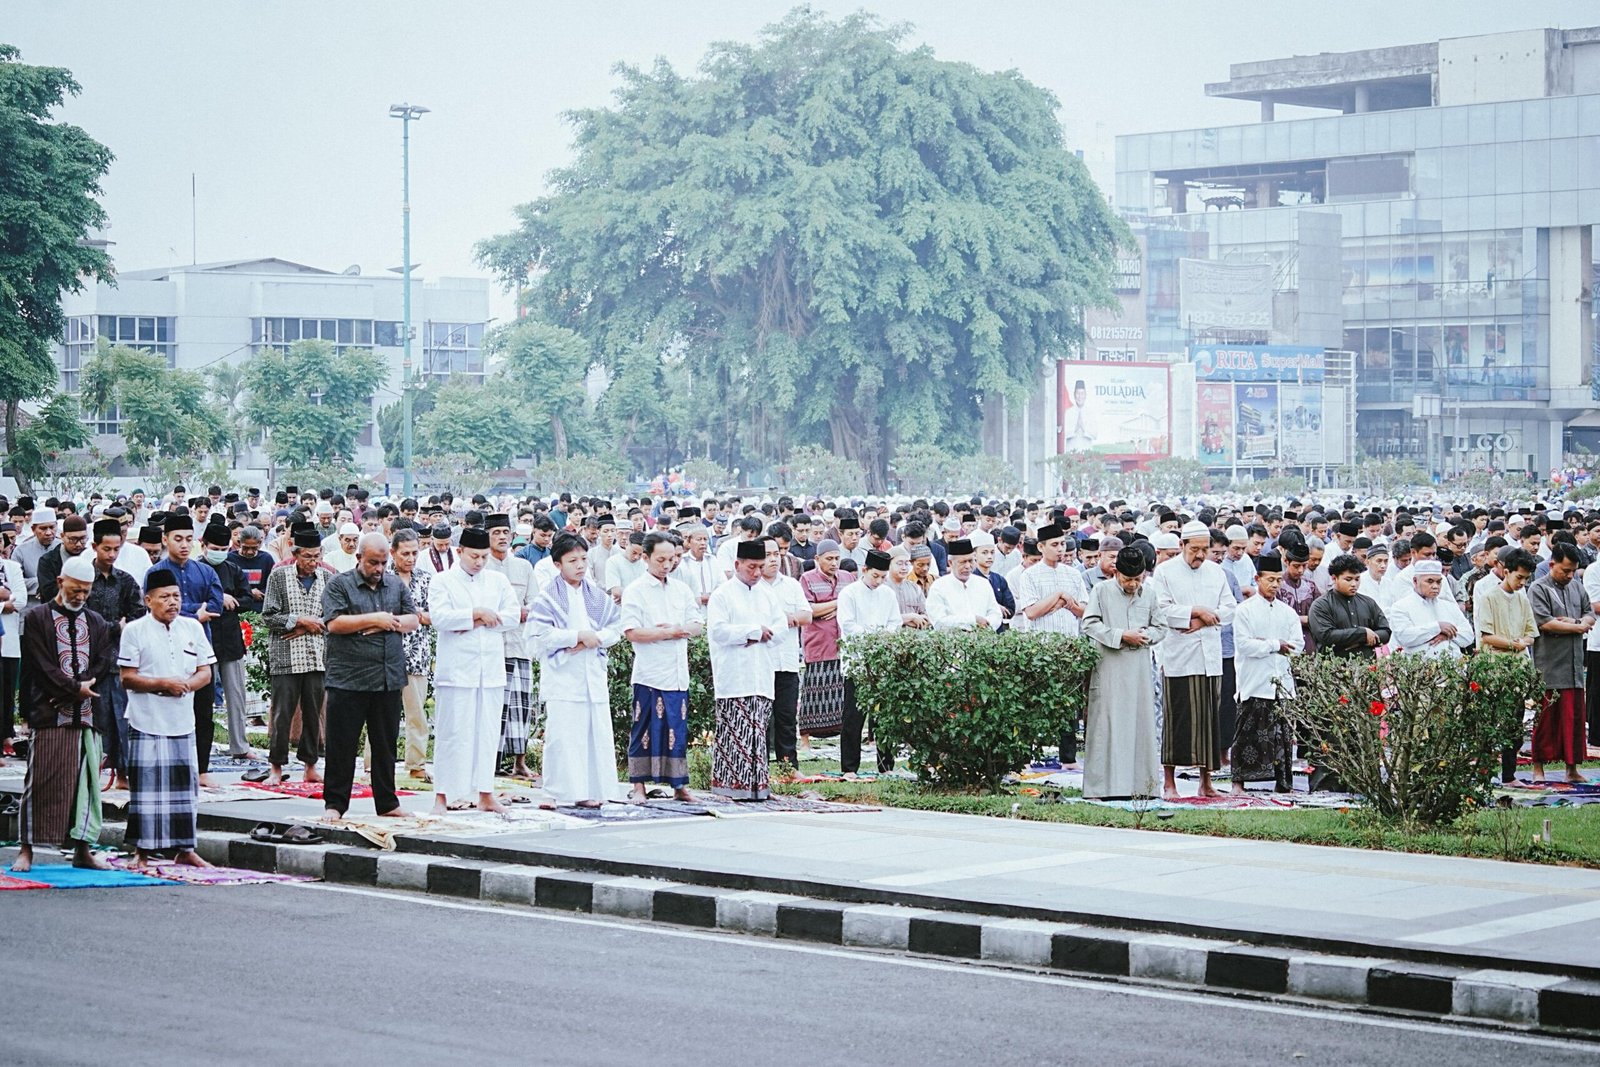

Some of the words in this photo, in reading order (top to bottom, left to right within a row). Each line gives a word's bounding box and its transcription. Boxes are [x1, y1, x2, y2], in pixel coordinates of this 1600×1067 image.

[1091, 326, 1143, 340] 08121557225
[1215, 350, 1257, 370] RITA
[1095, 385, 1146, 400] IDULADHA
